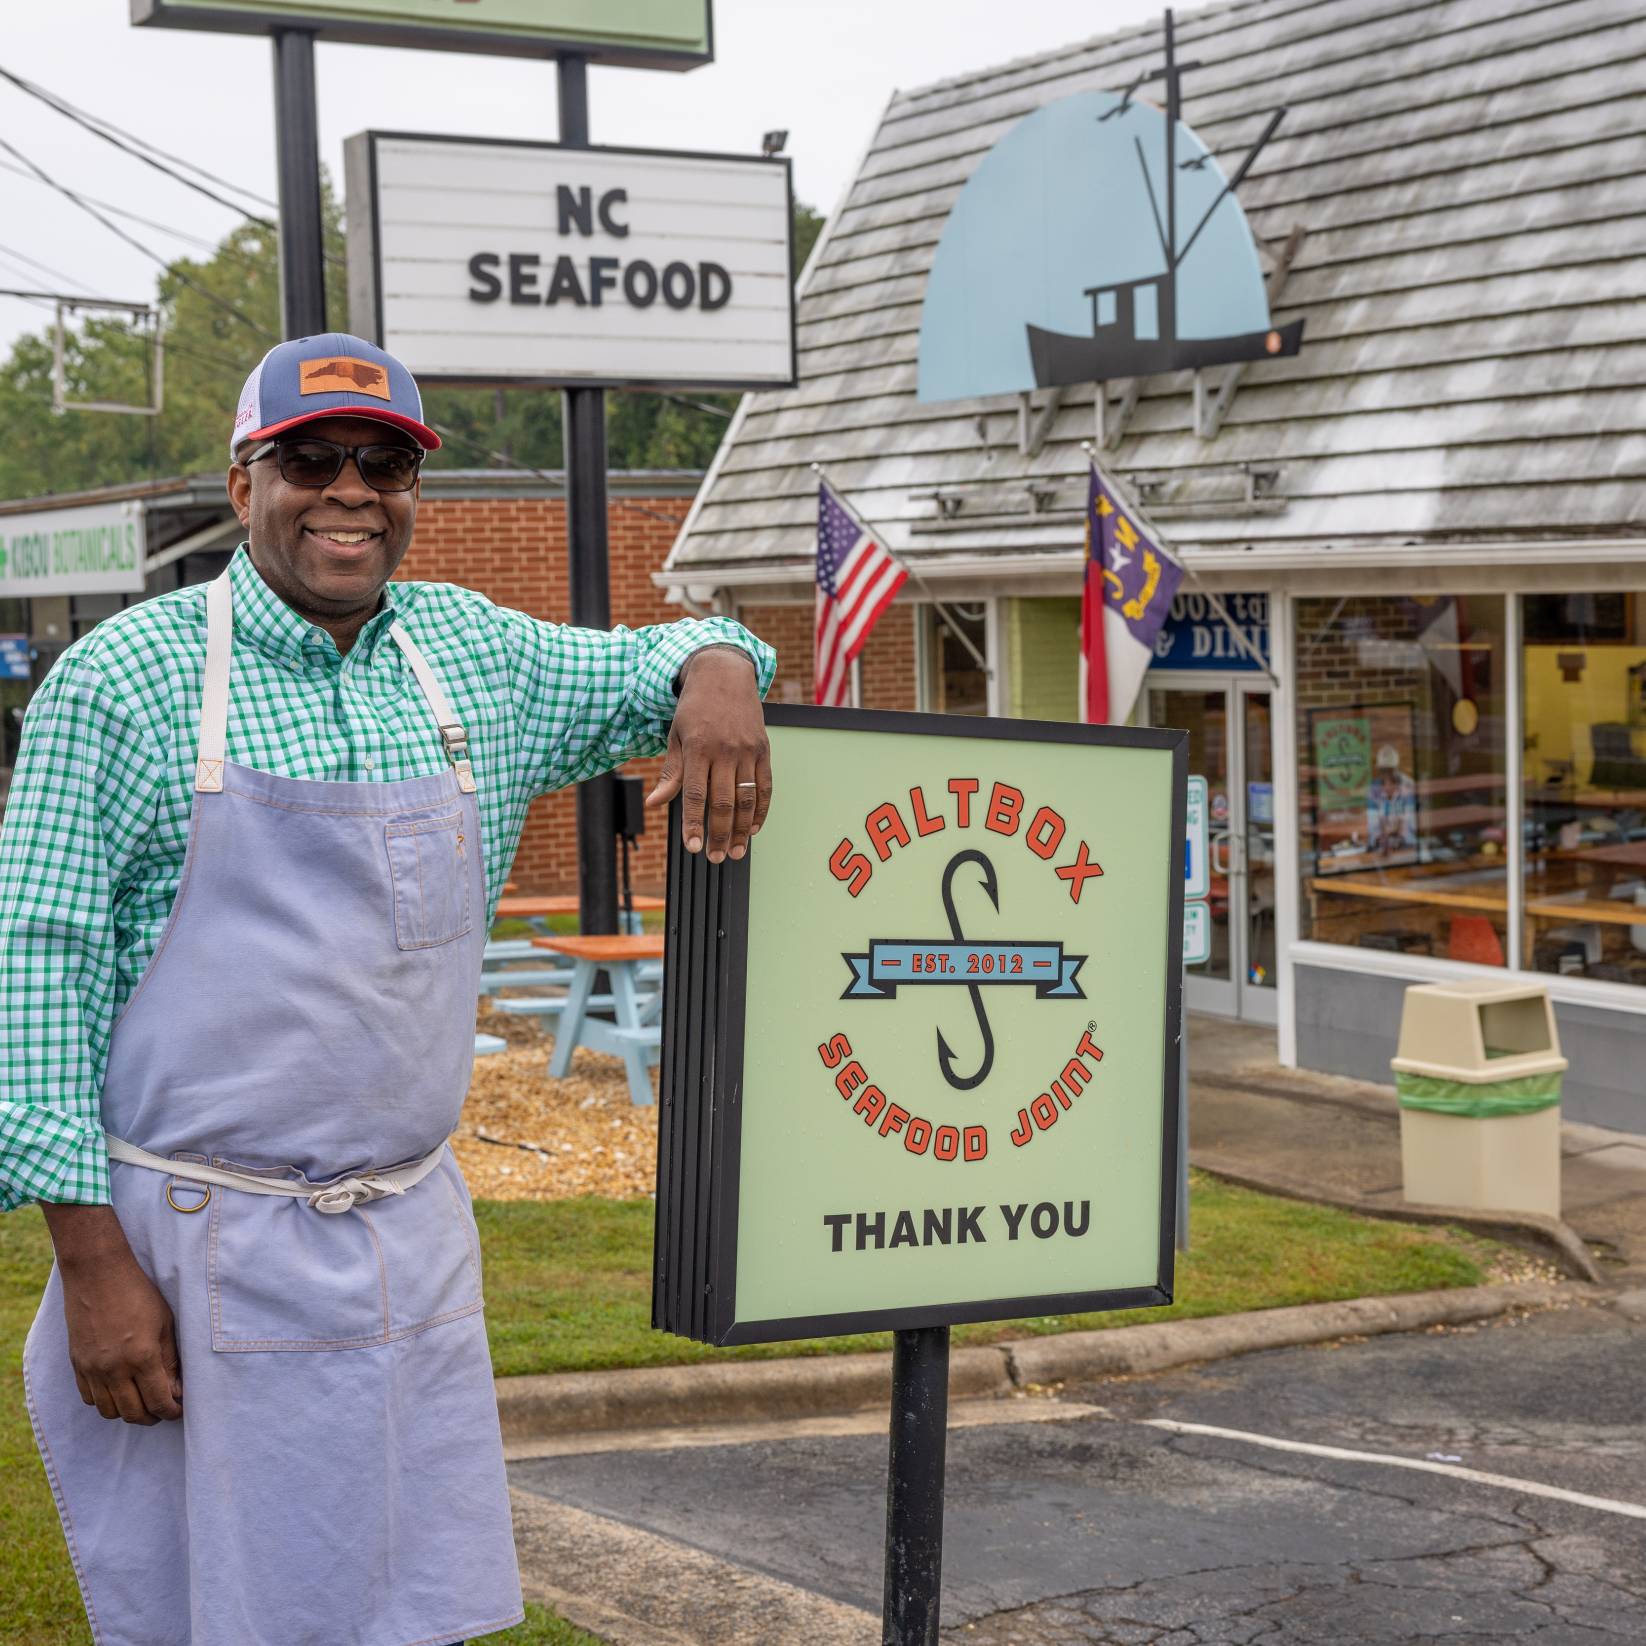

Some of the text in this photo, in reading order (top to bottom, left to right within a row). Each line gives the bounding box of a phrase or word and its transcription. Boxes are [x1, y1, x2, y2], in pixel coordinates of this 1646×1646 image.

[556, 184, 629, 238] NC
[468, 252, 733, 312] SEAFOOD
[829, 778, 1104, 904] SALTBOX
[912, 953, 1023, 974] EST. 2012
[817, 1033, 988, 1162] SEAFOOD
[823, 1200, 1091, 1252] THANK YOU
